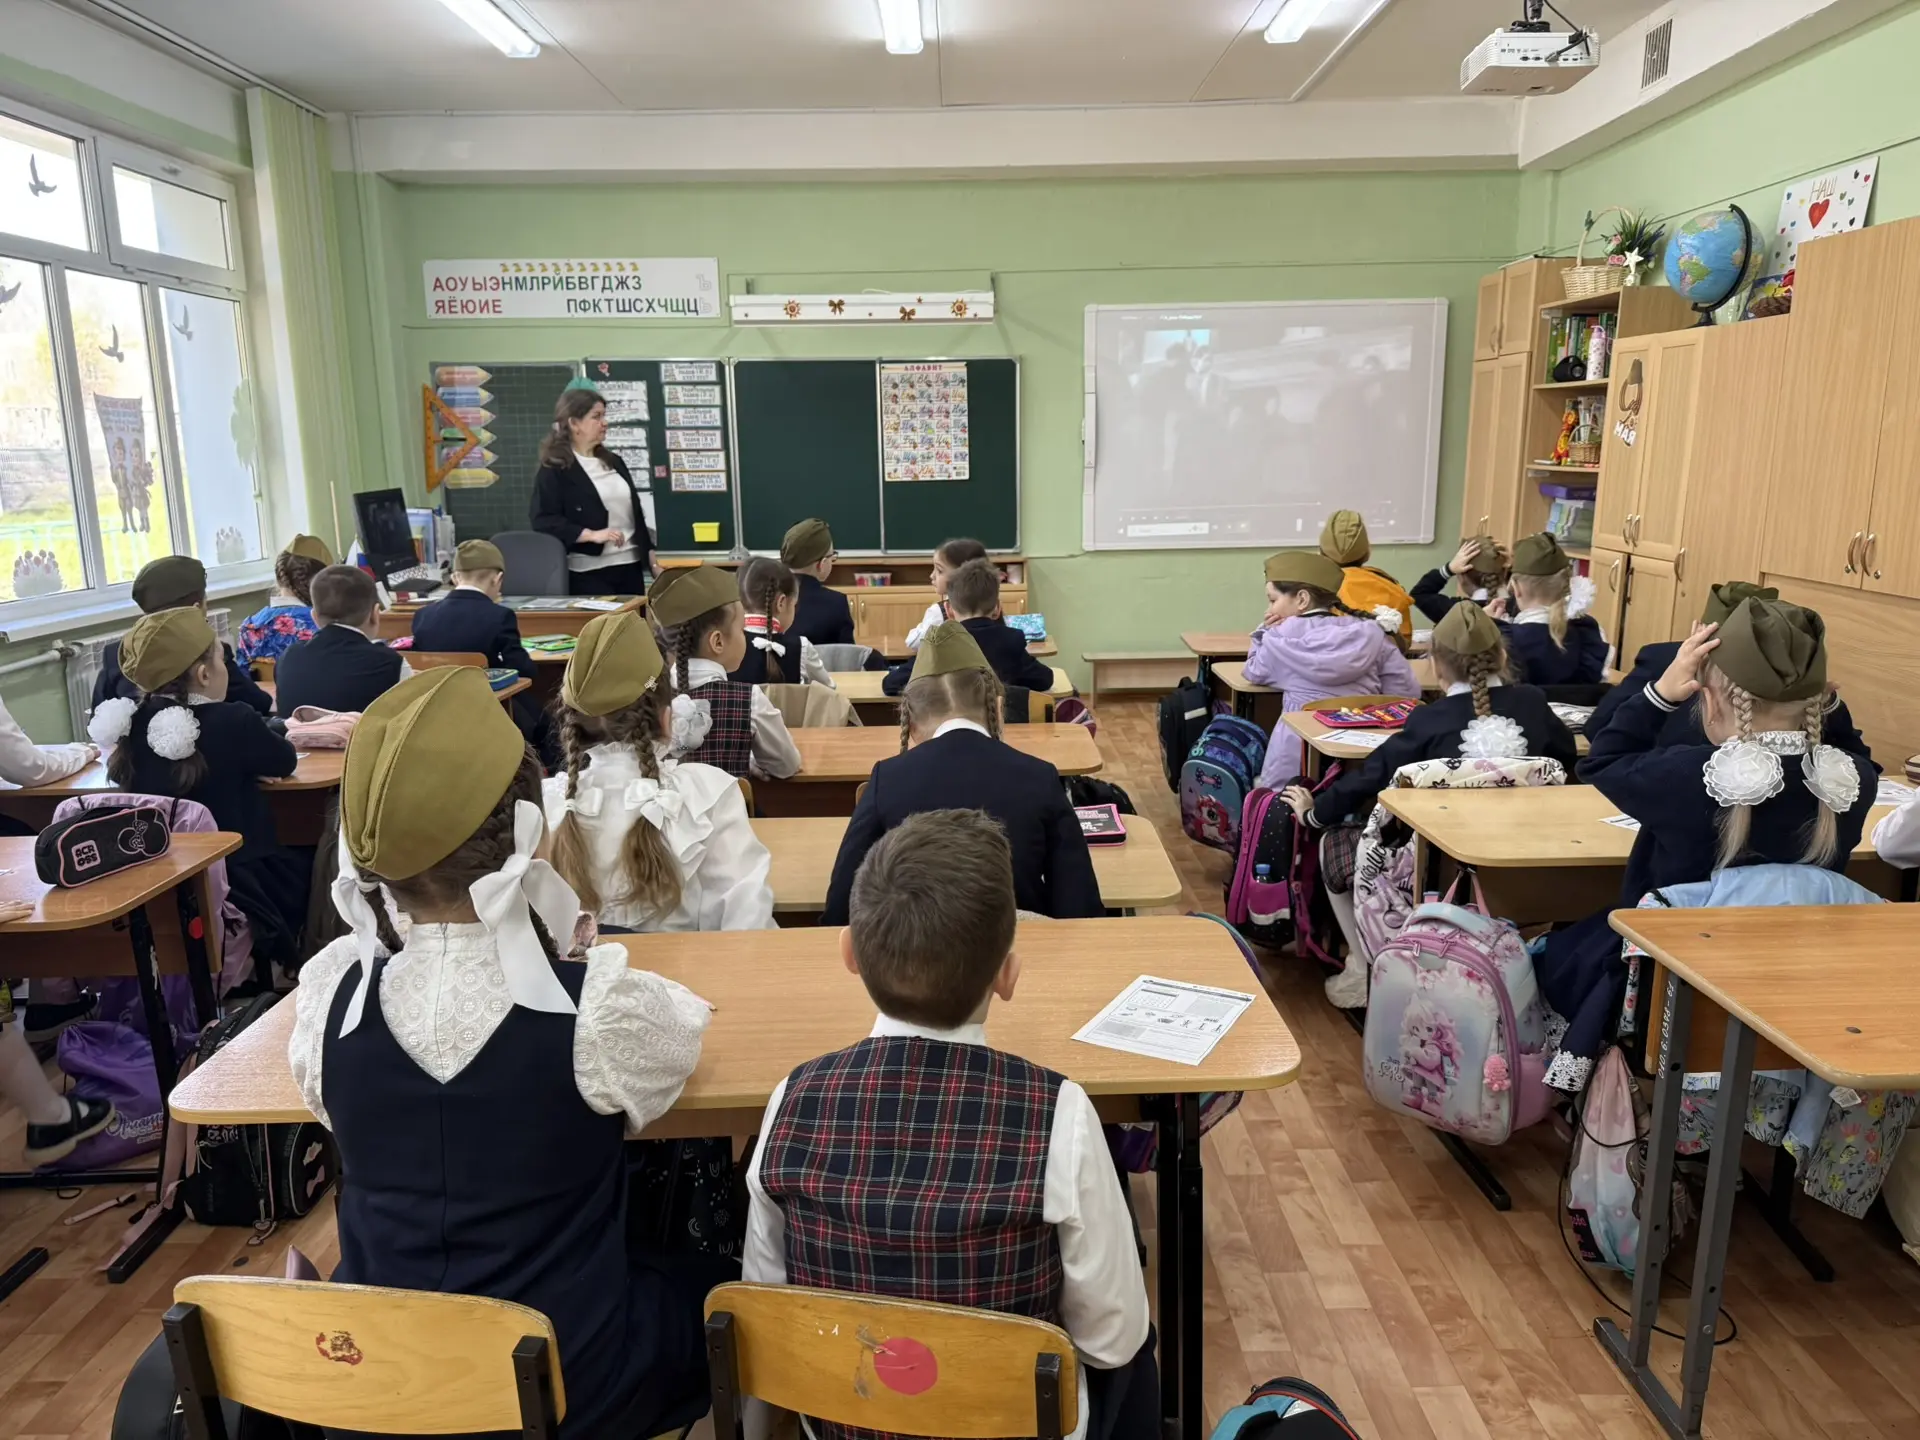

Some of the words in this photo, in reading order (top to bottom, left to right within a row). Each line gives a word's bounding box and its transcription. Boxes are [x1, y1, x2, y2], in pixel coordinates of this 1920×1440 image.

[1809, 175, 1838, 204] НАШ
[434, 295, 503, 315] ЯЁЮИЕ
[1614, 420, 1637, 446] МАЯ
